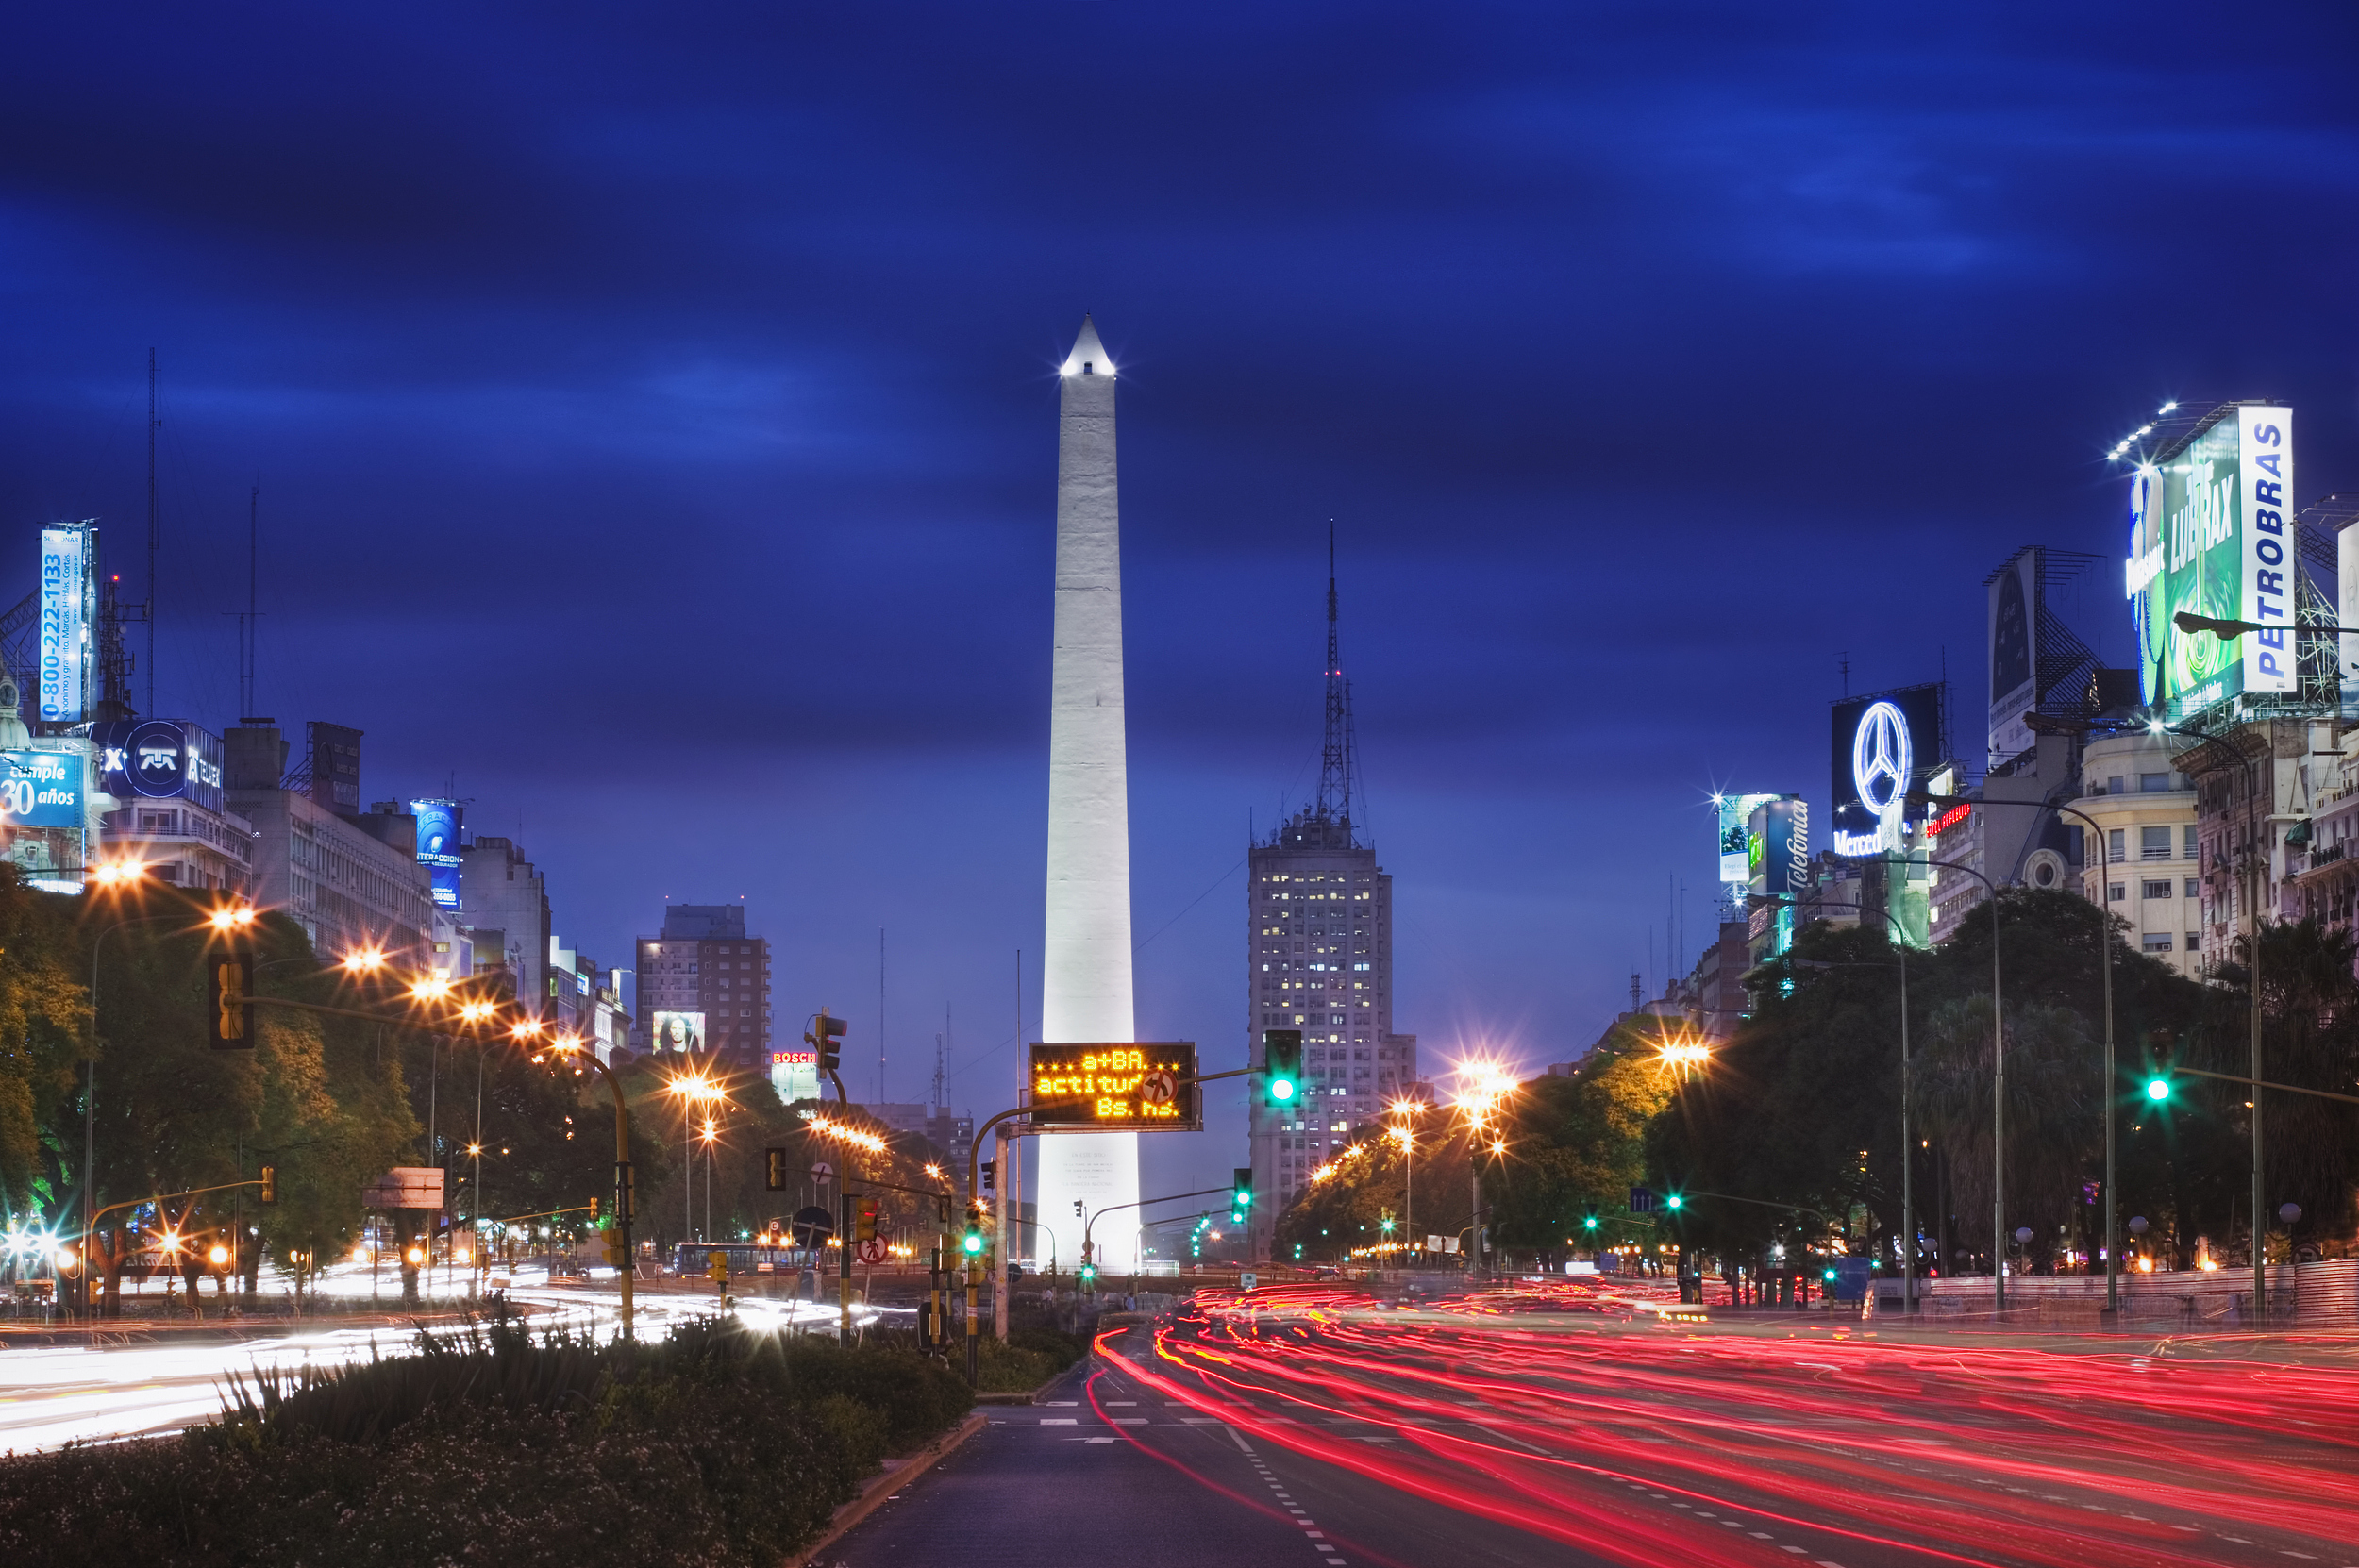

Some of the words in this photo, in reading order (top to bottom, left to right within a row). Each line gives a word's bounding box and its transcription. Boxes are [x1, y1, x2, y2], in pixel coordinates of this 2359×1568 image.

[2170, 473, 2234, 575] LUBRAX
[2254, 423, 2284, 679] PETROBRAS
[42, 554, 61, 716] 0-800-222-1133
[1, 779, 35, 815] 30
[38, 788, 75, 805] años
[10, 763, 66, 783] cumple
[773, 1052, 817, 1063] BOSCH
